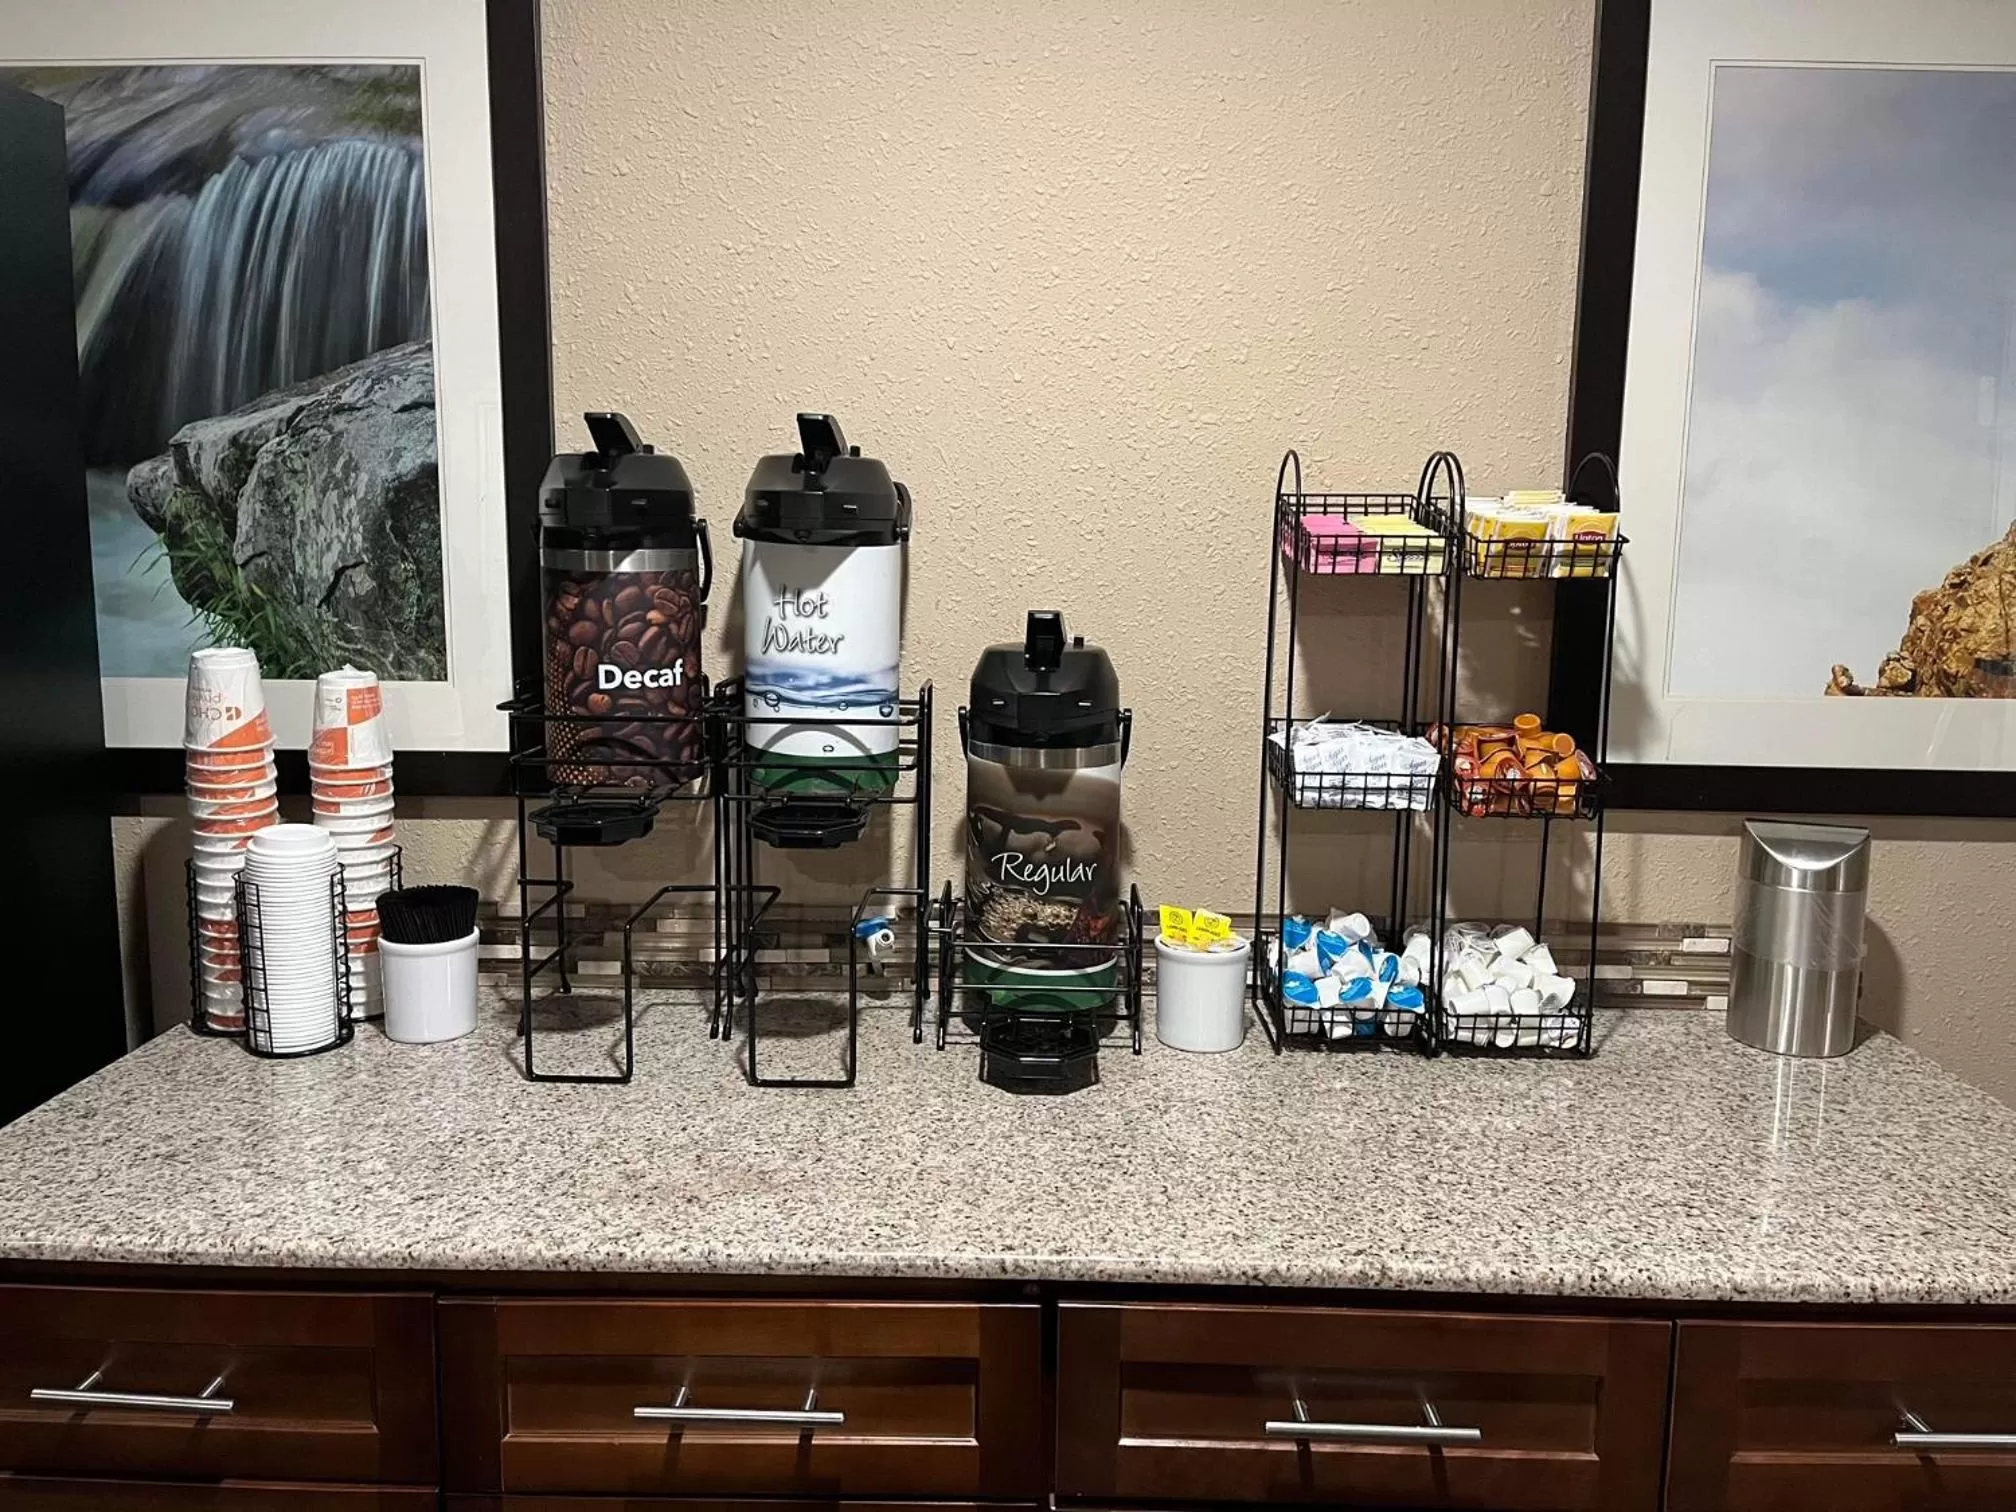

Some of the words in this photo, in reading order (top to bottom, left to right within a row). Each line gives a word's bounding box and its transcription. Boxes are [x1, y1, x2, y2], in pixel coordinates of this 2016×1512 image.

[774, 584, 828, 621] Hot
[761, 616, 845, 655] Water
[598, 658, 684, 690] Decaf
[991, 851, 1098, 896] Regular
